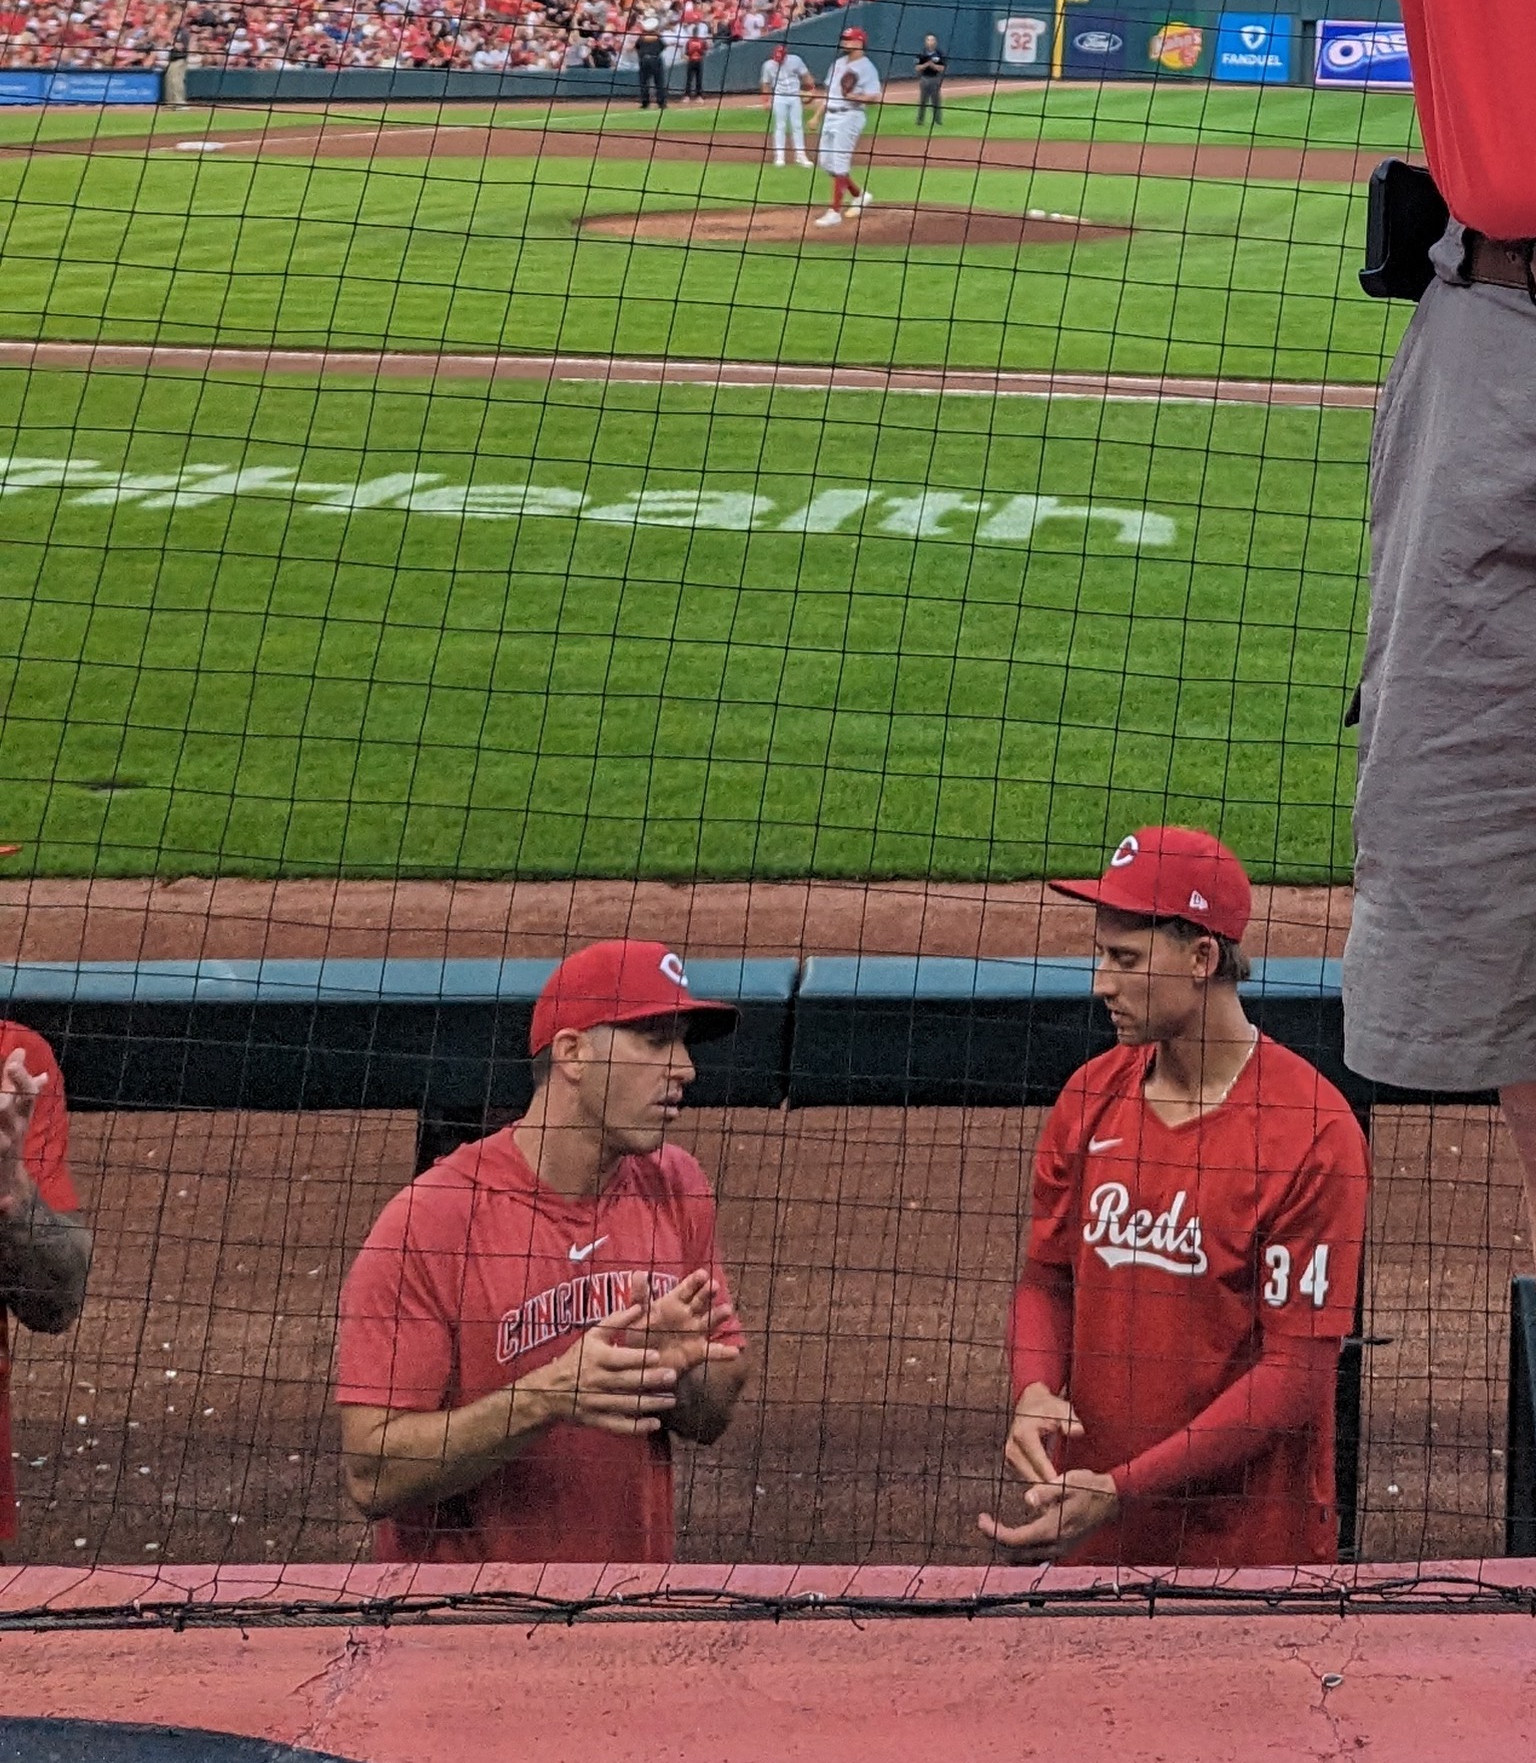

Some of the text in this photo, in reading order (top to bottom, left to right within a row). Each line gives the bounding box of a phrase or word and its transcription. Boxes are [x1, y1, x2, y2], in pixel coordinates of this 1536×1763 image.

[1009, 31, 1033, 51] 32
[1221, 52, 1283, 66] FANDUEL
[1327, 30, 1409, 67] ORE
[1082, 1181, 1208, 1276] Reds
[1263, 1243, 1330, 1307] 34
[496, 1270, 681, 1364] CINCINNT
